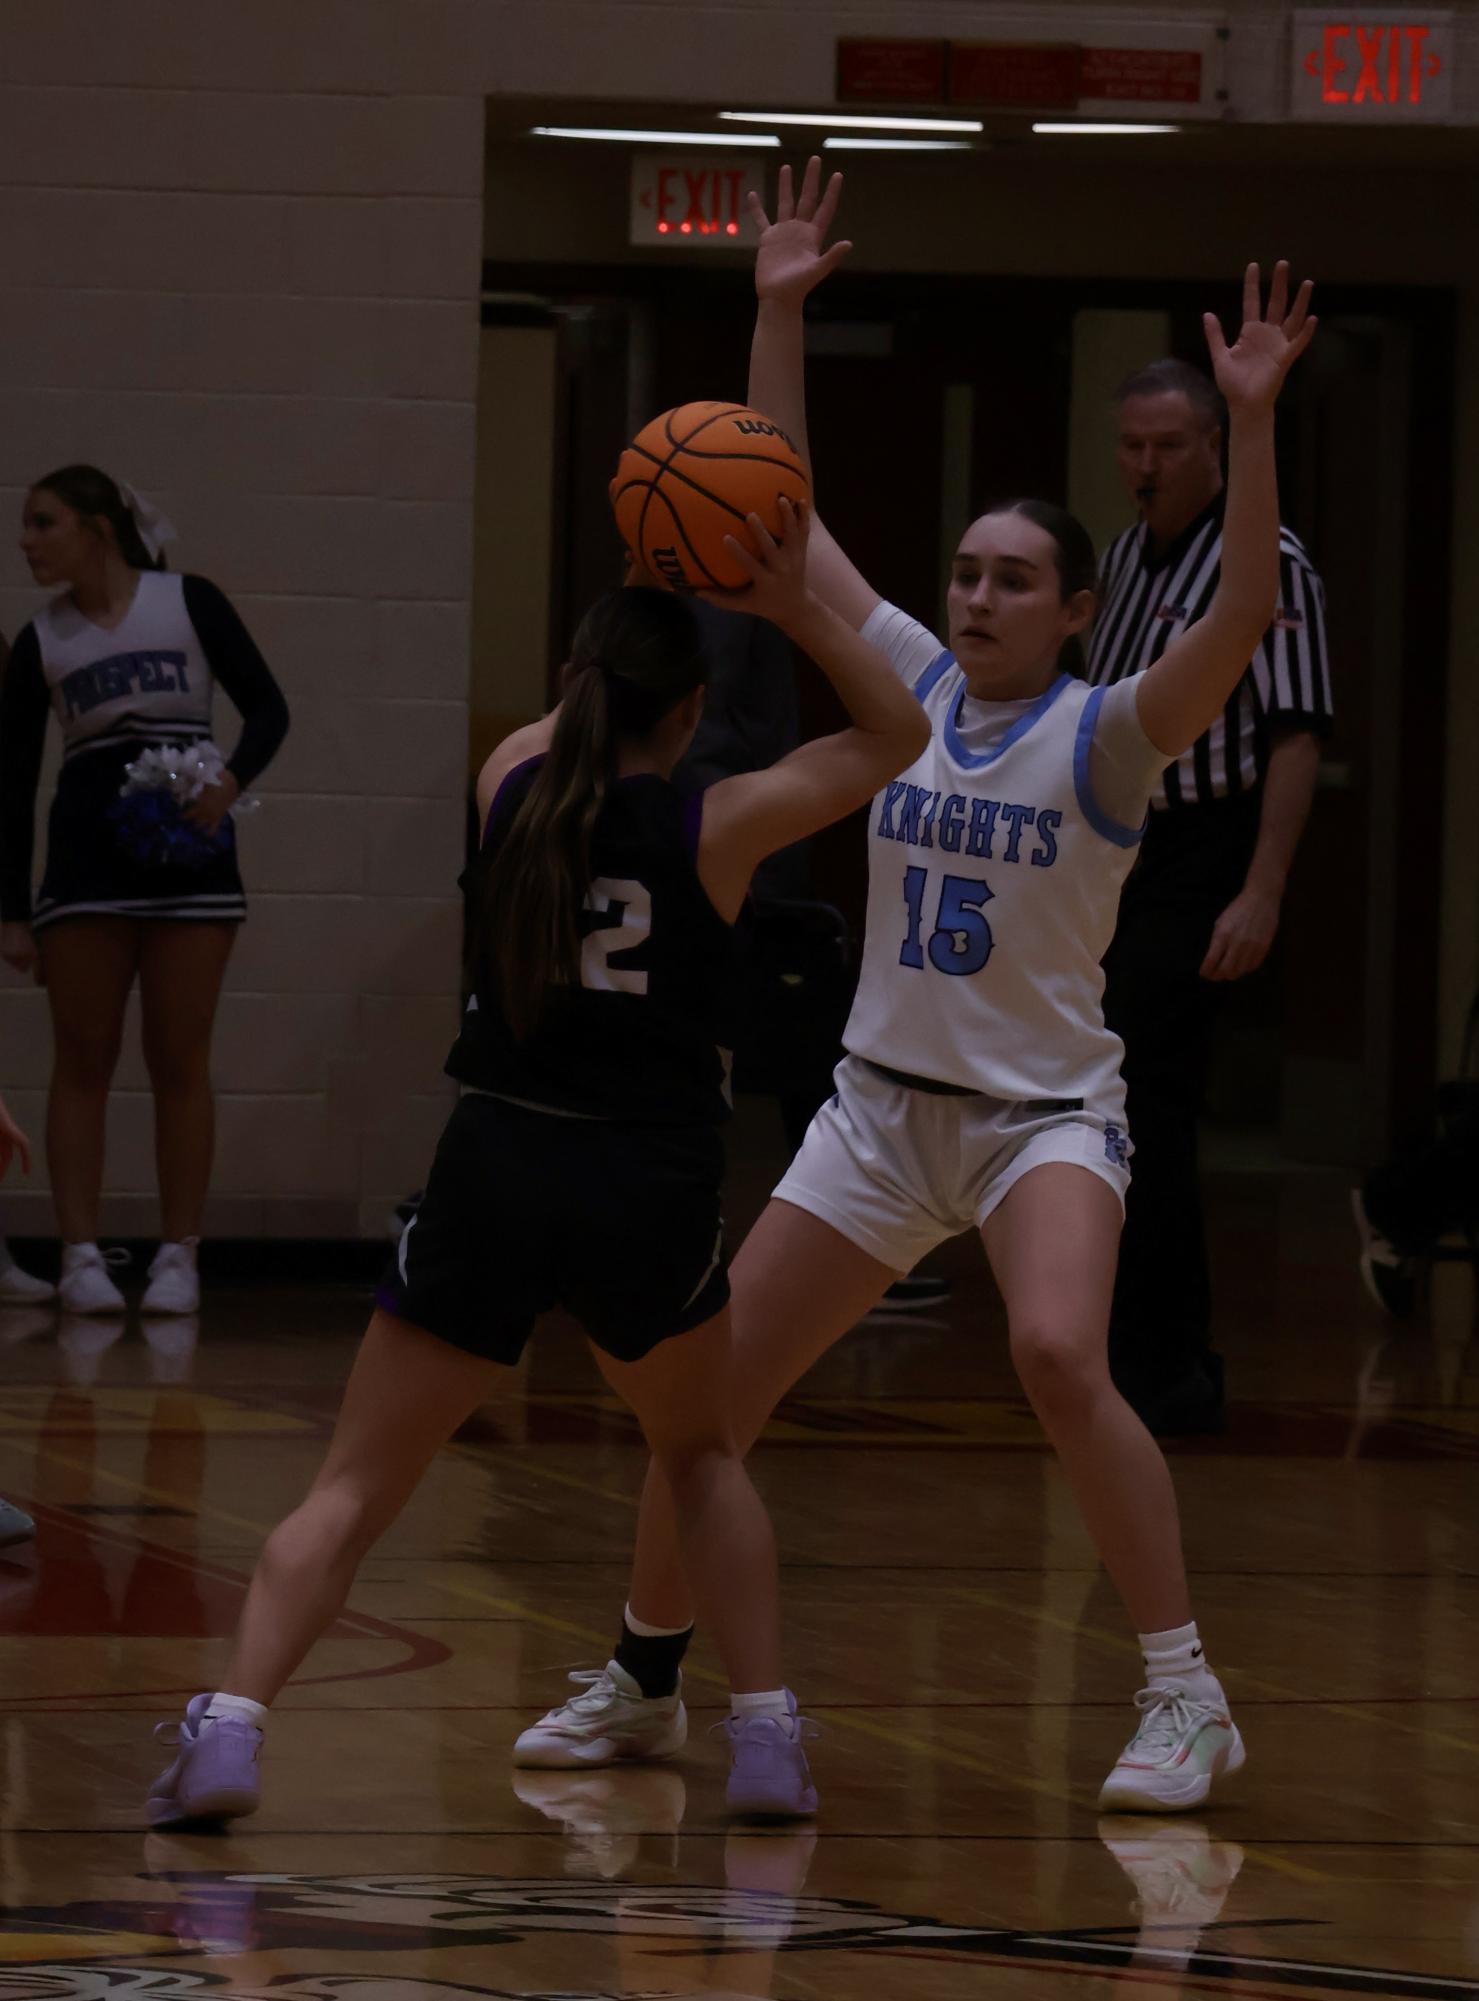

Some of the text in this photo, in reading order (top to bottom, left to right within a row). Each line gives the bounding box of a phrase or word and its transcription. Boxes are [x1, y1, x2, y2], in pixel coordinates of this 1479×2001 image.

[1322, 24, 1429, 104] EXIT
[657, 168, 747, 236] EXIT
[877, 781, 1064, 867] KNIGHTS
[552, 876, 653, 996] 2
[899, 865, 996, 976] 15
